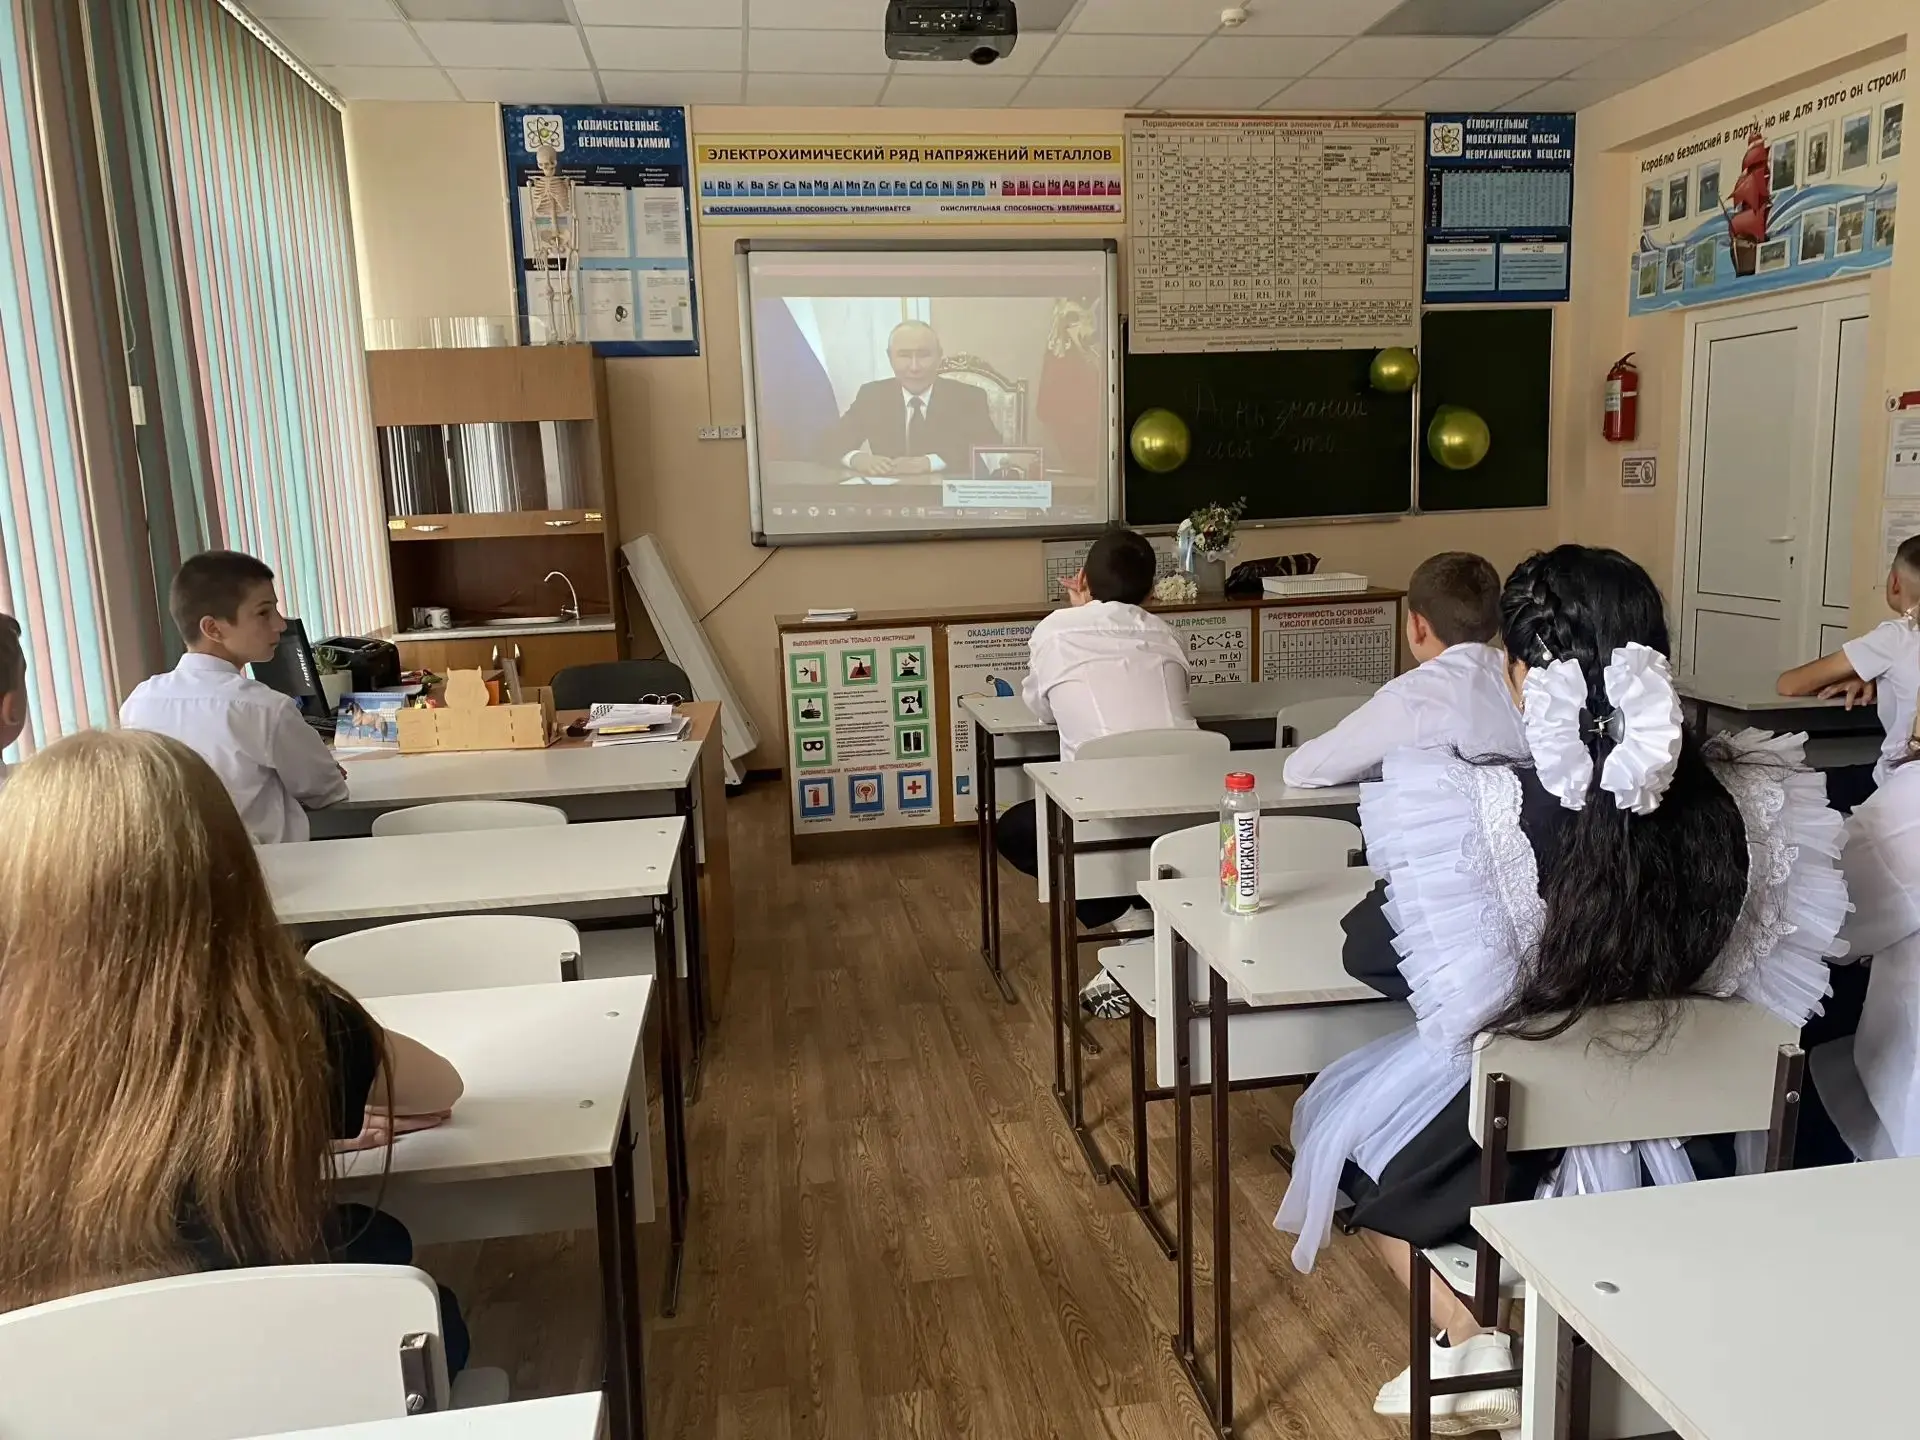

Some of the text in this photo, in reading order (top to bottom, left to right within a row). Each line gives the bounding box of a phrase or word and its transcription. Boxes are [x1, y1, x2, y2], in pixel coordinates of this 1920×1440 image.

[577, 120, 660, 131] КОЛИЧЕСТВЕННЫЕ
[1466, 119, 1529, 129] ОТНОСИТЕЛЬНЫЕ
[1641, 68, 1906, 173] Кораблю безопасней в порту, но не для этого он строил
[578, 136, 670, 148] ВЕЛИЧИНЫ В ХИМИИ
[1466, 134, 1560, 144] МОЛЕКУЛЯРНЫЕ МАССЫ
[708, 146, 1112, 162] ЭЛЕКТРОХИМИЧЕСКИЙ РЯД НАПРЯЖЕНИЙ МЕТАЛЛОВ
[1466, 149, 1571, 161] НЕОРГАНИЧЕСКИХ ВЕЩЕСТВ
[704, 180, 1120, 190] Li Rb K Ba Sr Ca Na Mg Al Mn Zn Cr Fe Cd Co Ni Sn Pb H Sb Bi Cu Hg Ag Pd Pt Au
[1268, 606, 1386, 620] РАСТВОРИМОСТЬ ОСНОВАНИЙ,
[1176, 619, 1190, 628] ДЛЯ
[1192, 616, 1226, 626] РАСЧЕТОВ
[1280, 620, 1310, 628] КИСЛОТ
[1320, 618, 1346, 626] СОЛЕЙ
[1354, 616, 1375, 624] ВОДЕ
[967, 628, 1004, 638] ОКАЗАНИЕ
[1190, 634, 1196, 642] A
[1224, 630, 1242, 639] C-B
[1190, 642, 1197, 650] B
[1206, 636, 1214, 646] C
[1190, 675, 1202, 683] PV
[1238, 817, 1254, 897] СЕНЕЖСКАЯ
